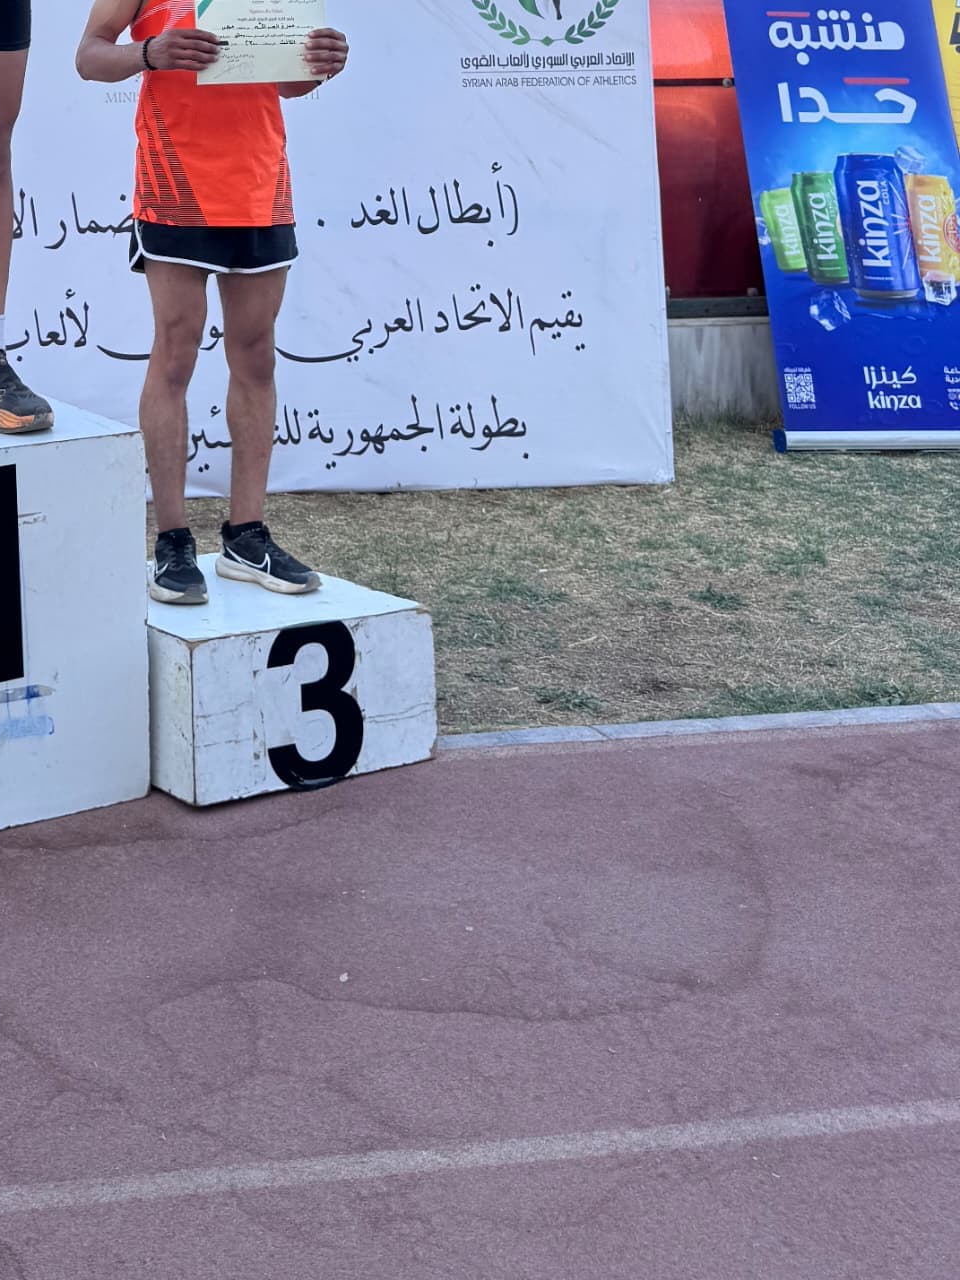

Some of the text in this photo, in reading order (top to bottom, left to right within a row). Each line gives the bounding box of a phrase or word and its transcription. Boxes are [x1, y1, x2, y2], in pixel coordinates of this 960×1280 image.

[462, 75, 637, 87] SYRIAN ARAB FEDERATION OF ATHLETICS
[777, 81, 917, 124] حدا
[351, 186, 411, 229] الغد
[774, 205, 801, 256] kinza
[808, 192, 839, 260] kinza
[856, 180, 892, 267] kinza
[917, 194, 942, 263] kinza
[274, 297, 424, 363] العربي
[434, 283, 524, 333] الاتحاد
[529, 290, 586, 356] يقيم
[863, 365, 917, 389] كينزا
[867, 390, 922, 412] kinza
[307, 394, 443, 469] الجمهورية
[450, 394, 529, 459] بطولة
[267, 620, 364, 791] 3
